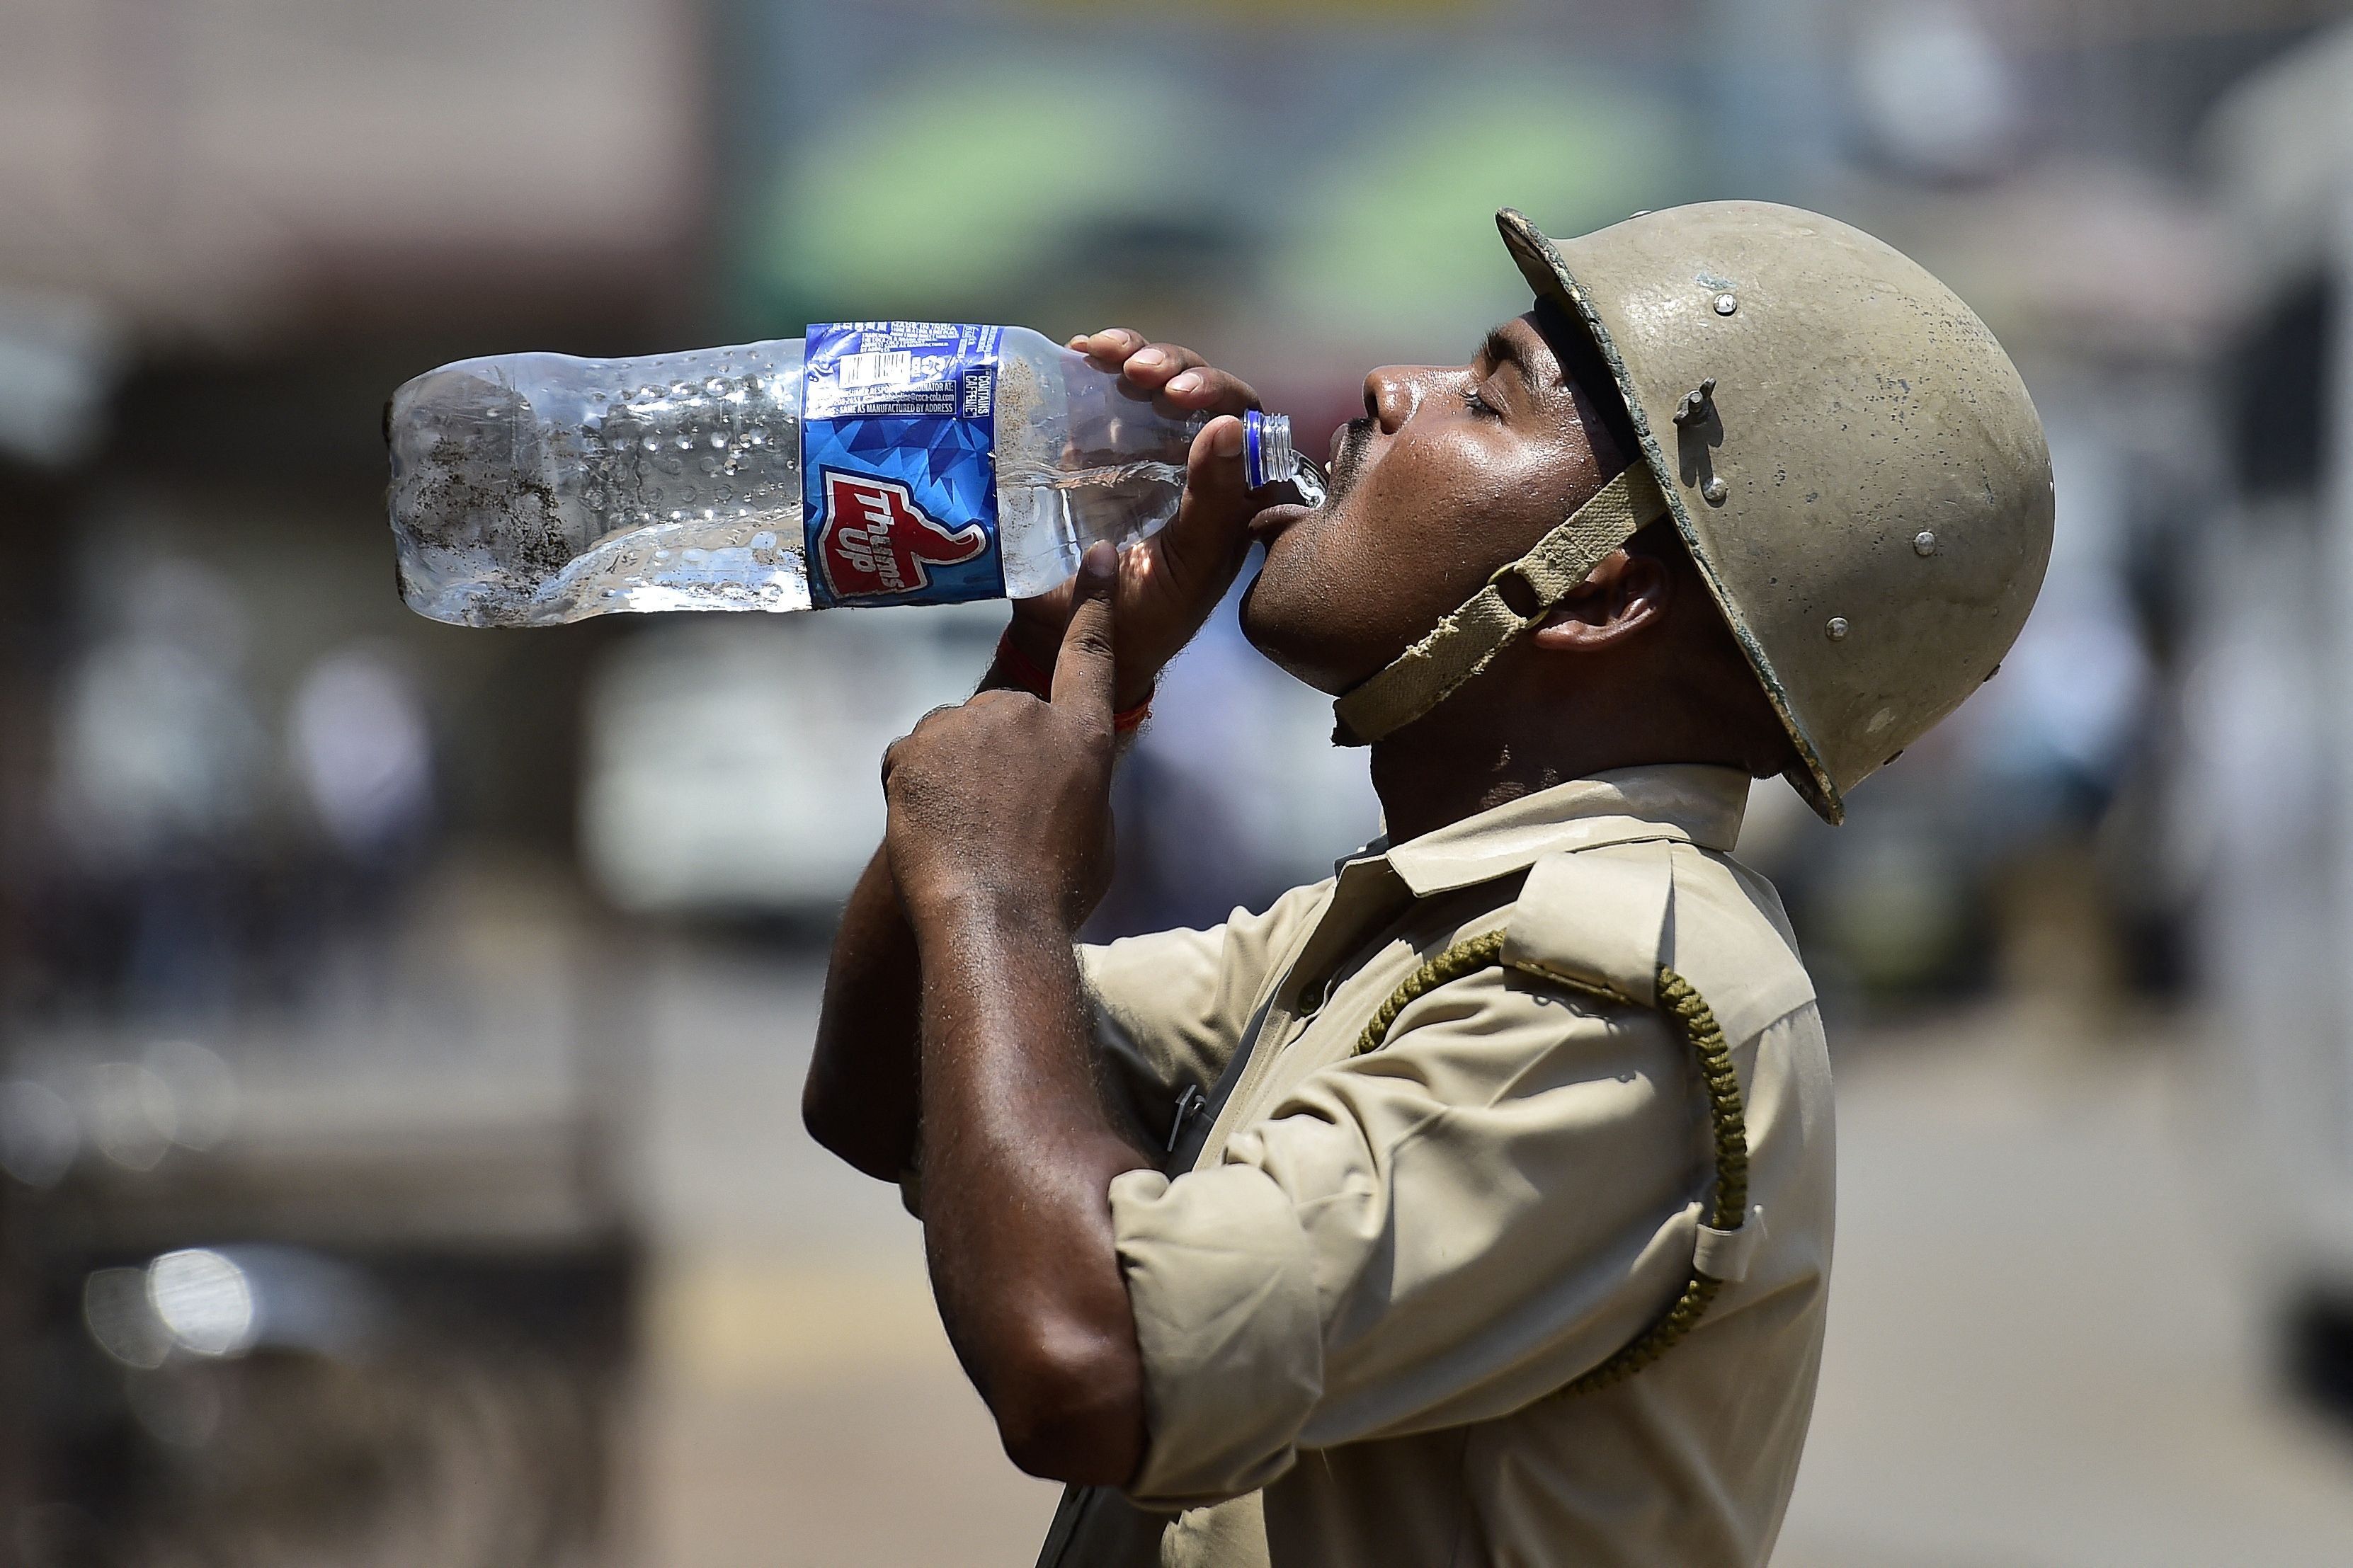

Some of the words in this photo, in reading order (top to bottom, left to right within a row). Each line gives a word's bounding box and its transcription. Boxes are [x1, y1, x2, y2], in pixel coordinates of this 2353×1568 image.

[839, 404, 858, 413] SAME
[858, 404, 866, 413] AS
[866, 403, 916, 413] MANUFACTURED
[916, 403, 924, 413] BY
[925, 403, 953, 413] ADDRESS
[835, 527, 876, 573] Up
[854, 491, 905, 591] Thums
